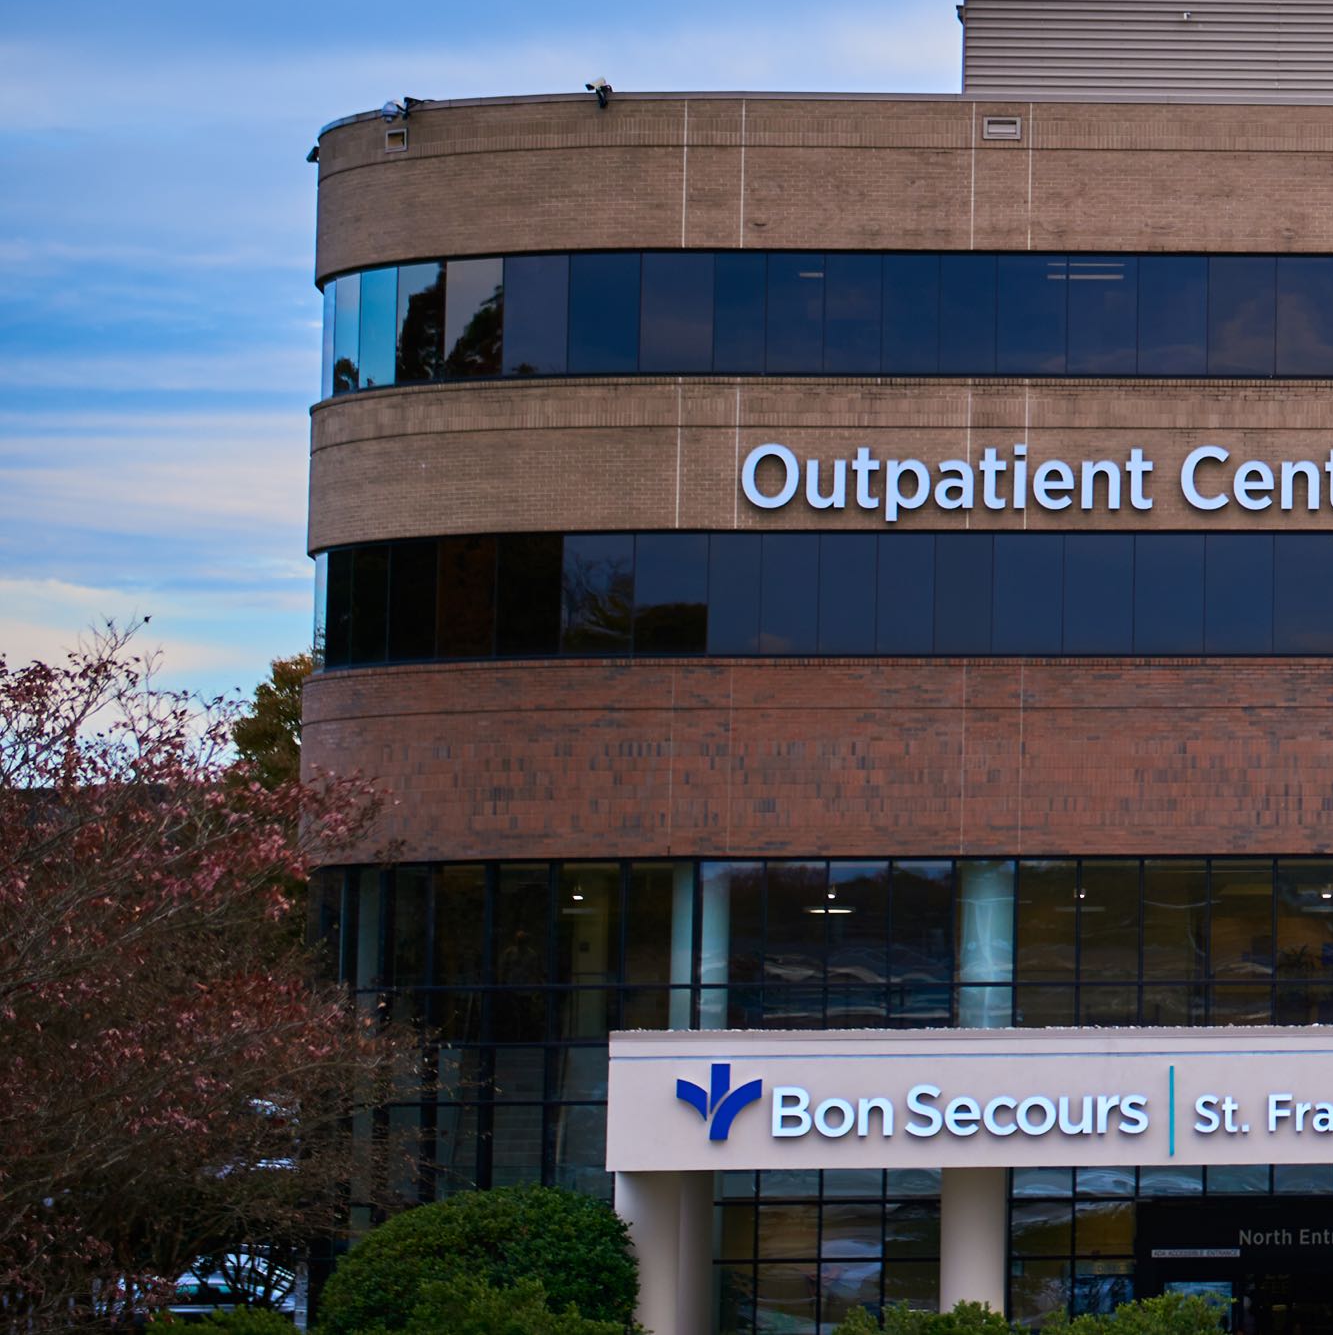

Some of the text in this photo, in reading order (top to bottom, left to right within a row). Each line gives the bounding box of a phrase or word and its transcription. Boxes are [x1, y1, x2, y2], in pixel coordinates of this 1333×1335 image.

[741, 443, 1154, 522] Outpatient
[771, 1084, 1149, 1138] Bon Secours
[1193, 1093, 1250, 1133] St.
[1239, 1228, 1293, 1246] North
